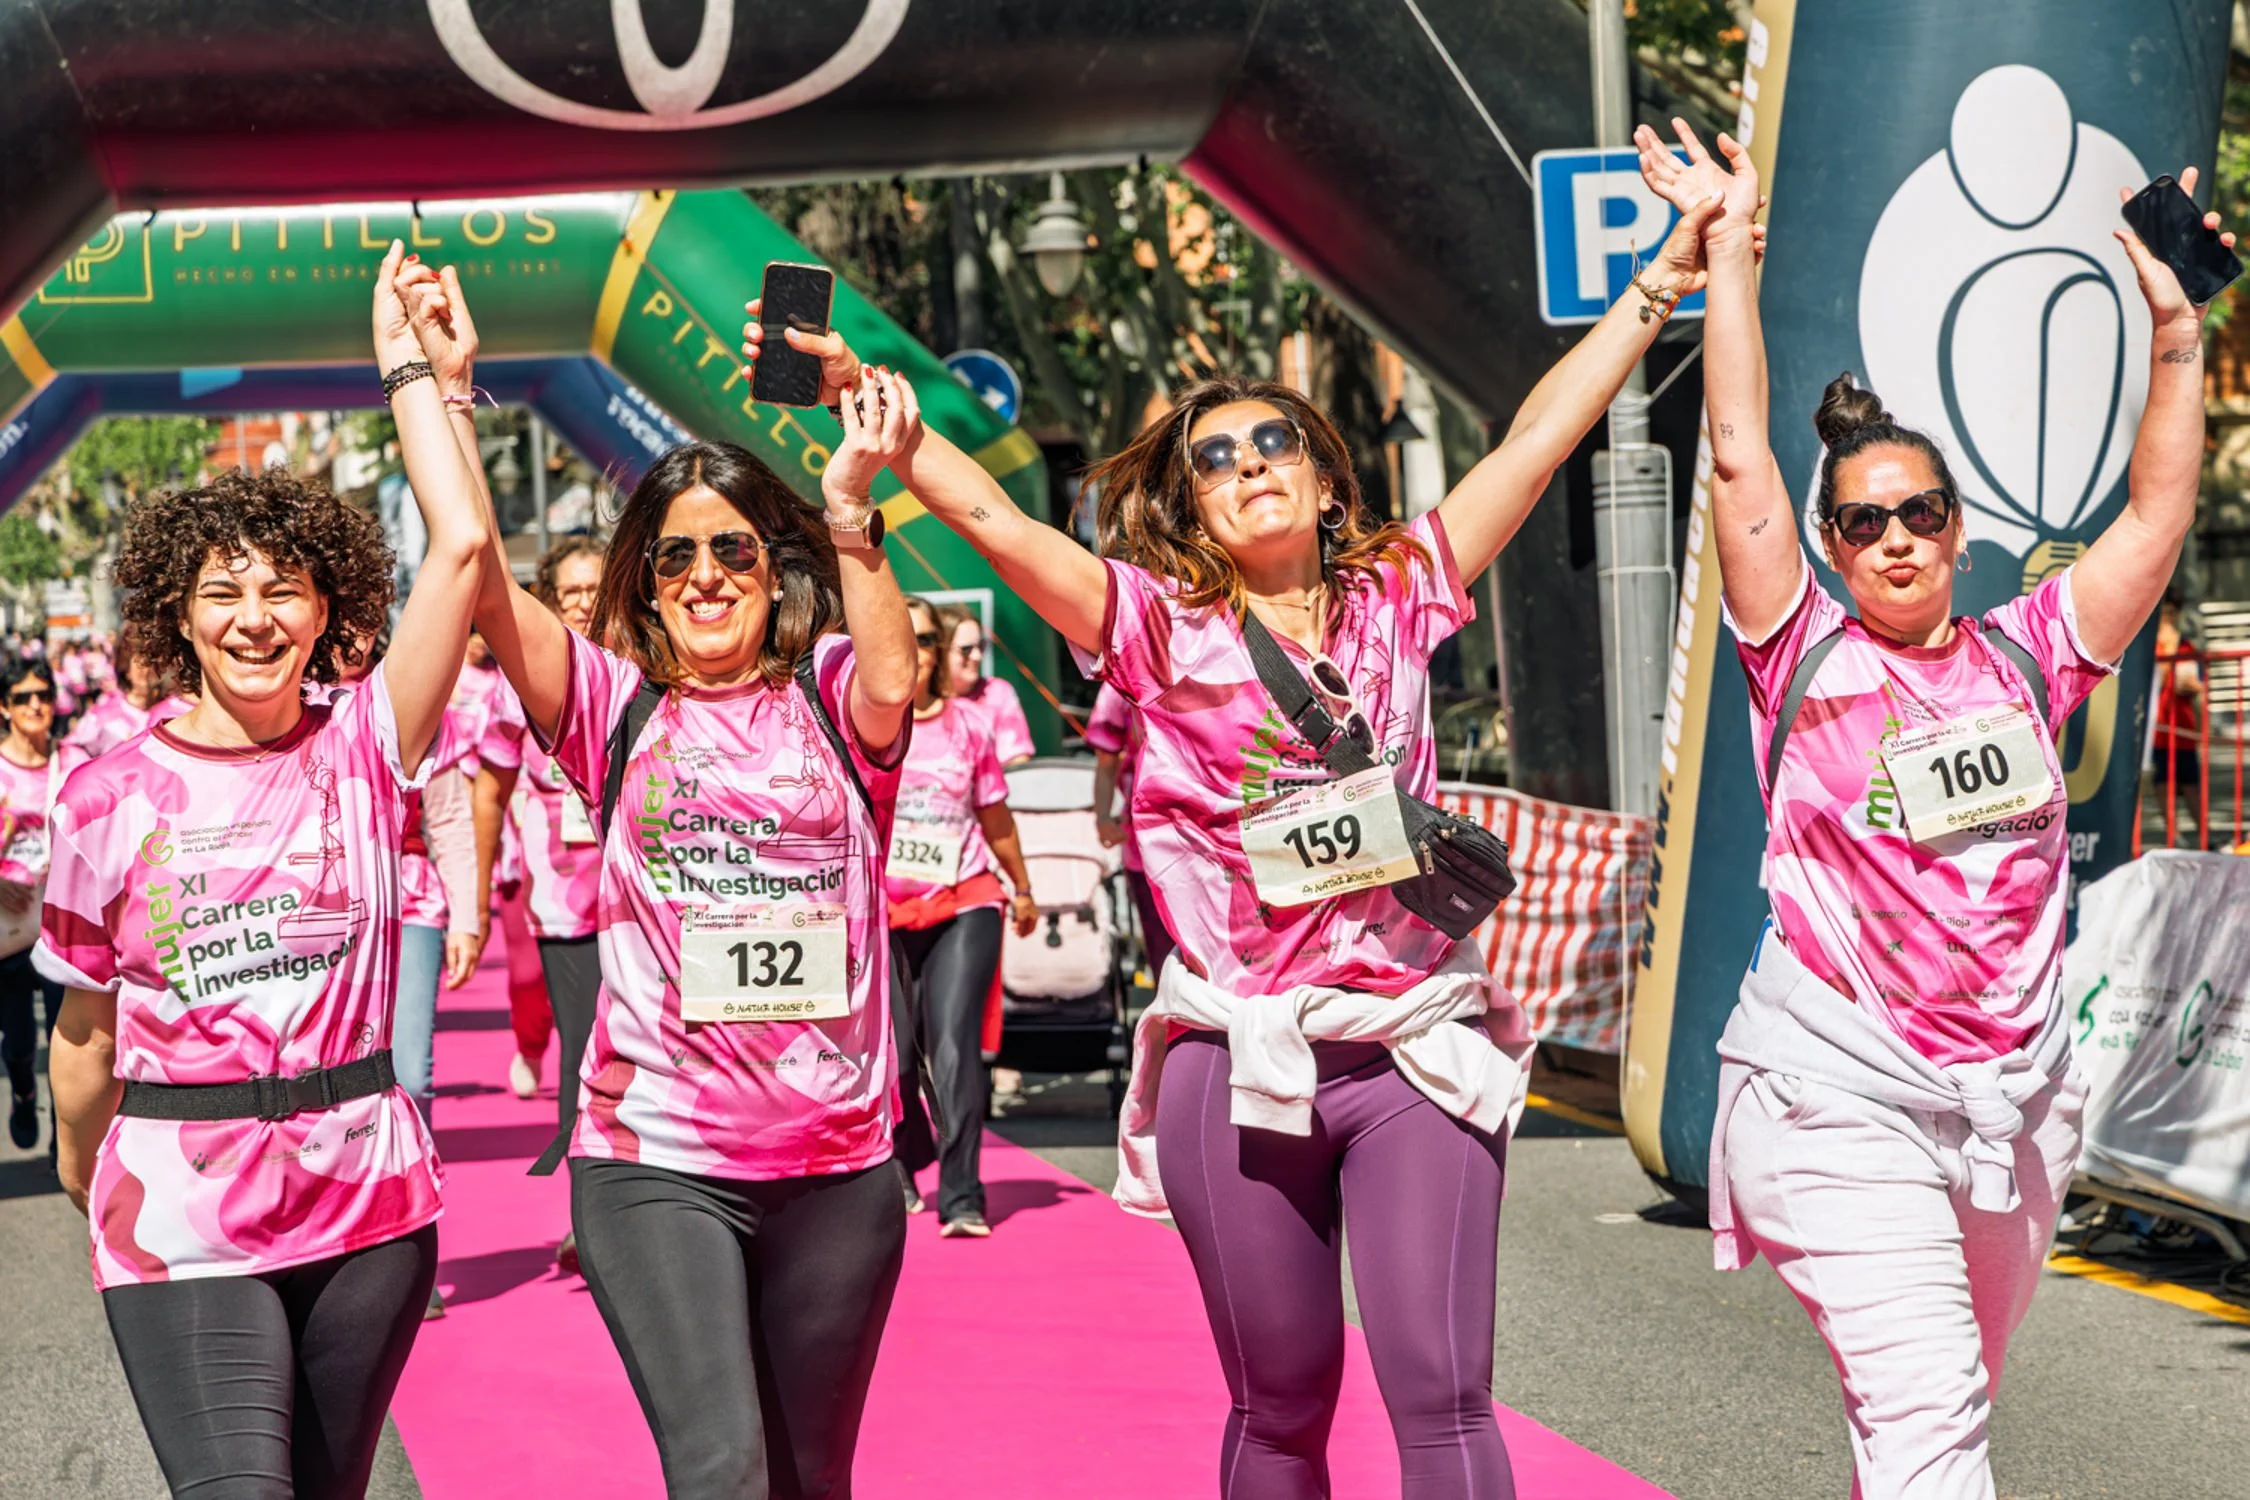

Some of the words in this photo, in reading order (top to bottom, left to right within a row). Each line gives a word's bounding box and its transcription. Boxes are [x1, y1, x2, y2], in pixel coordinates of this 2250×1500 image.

[1572, 169, 1671, 301] P
[641, 289, 832, 477] PITILLO
[672, 776, 699, 799] XI
[1928, 743, 2010, 799] 160
[668, 808, 779, 836] Carrera
[669, 843, 718, 868] por
[724, 841, 752, 865] la
[892, 837, 943, 866] 3324
[1282, 814, 1361, 869] 159
[178, 872, 206, 900] XI
[181, 892, 298, 930] Carrera
[187, 936, 238, 971] por
[243, 927, 275, 953] la
[726, 940, 805, 988] 132
[772, 1002, 804, 1012] HOUSE
[344, 1121, 377, 1144] Ferrer
